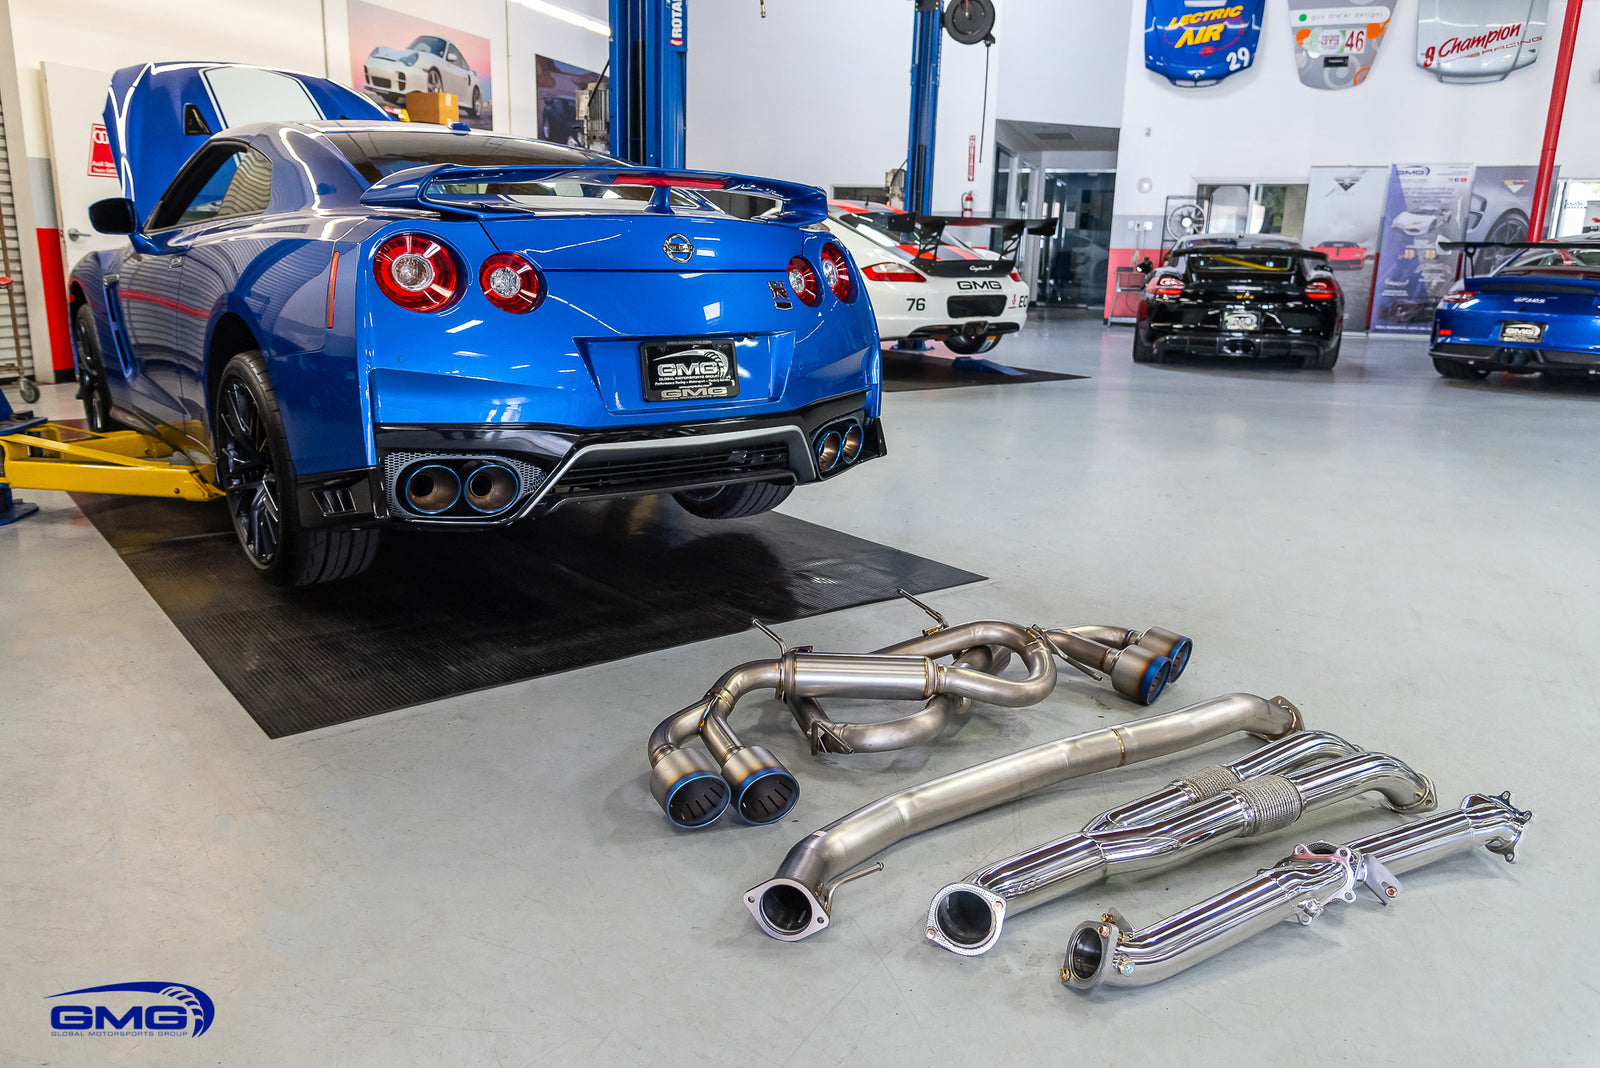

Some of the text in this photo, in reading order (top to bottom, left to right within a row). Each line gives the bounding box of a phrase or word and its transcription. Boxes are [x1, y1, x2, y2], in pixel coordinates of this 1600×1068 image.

[671, 0, 682, 38] ROTA
[1169, 5, 1244, 28] LECTRIC
[1174, 23, 1225, 48] AIR
[1345, 30, 1365, 51] 46
[1438, 23, 1522, 58] Champion
[1226, 47, 1250, 71] 29
[957, 280, 1002, 290] GMG
[906, 298, 926, 311] 76
[657, 361, 719, 376] GMG
[661, 386, 728, 398] GMG
